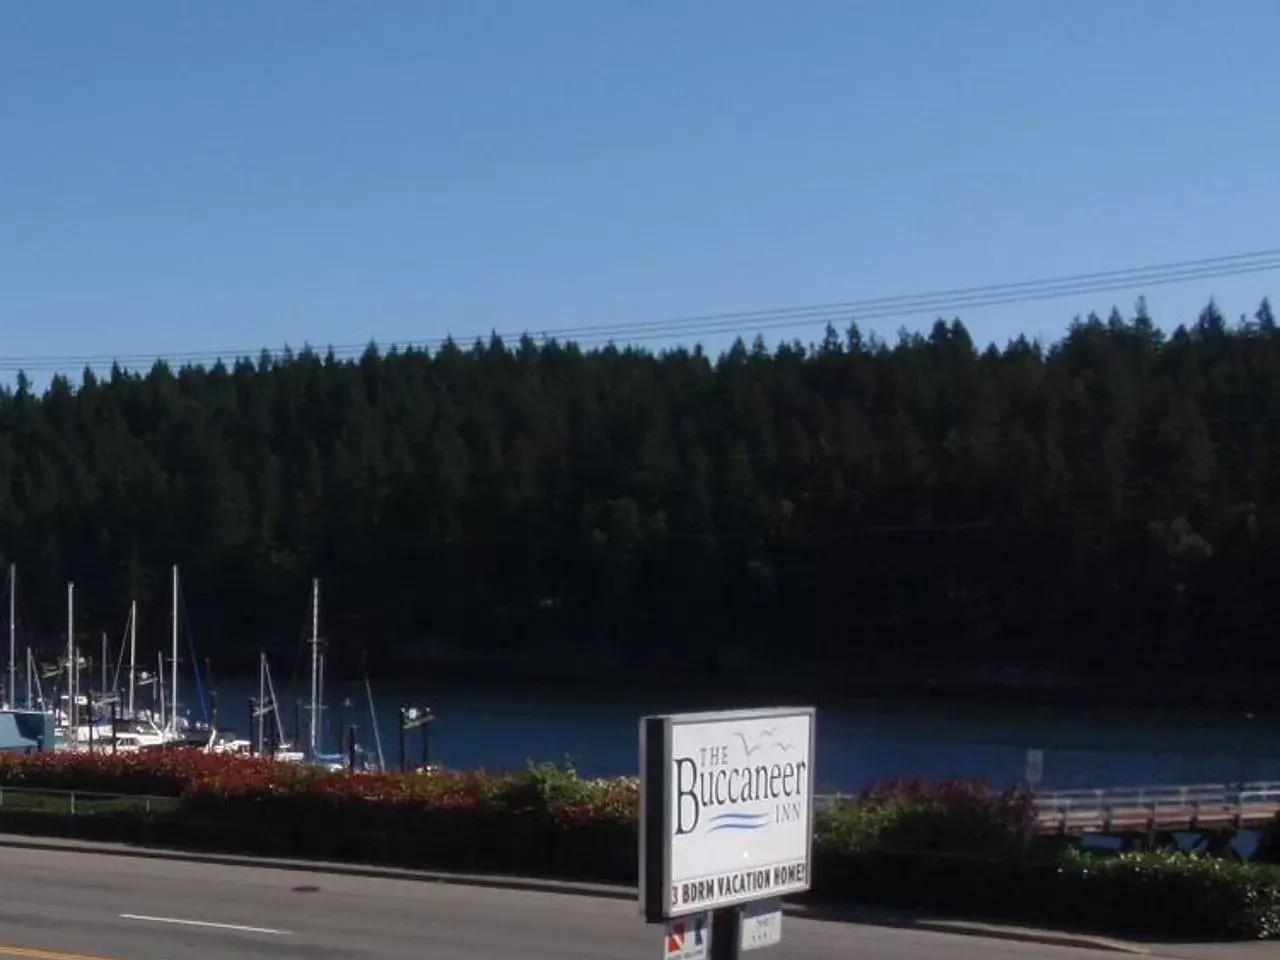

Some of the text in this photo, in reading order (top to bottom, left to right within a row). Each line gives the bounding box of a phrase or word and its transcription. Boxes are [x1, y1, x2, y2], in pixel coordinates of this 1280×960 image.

[700, 746, 728, 767] THE
[673, 757, 806, 835] Buccaneer
[775, 803, 802, 823] INN
[682, 880, 714, 903] BDRM
[717, 869, 771, 896] VACATION
